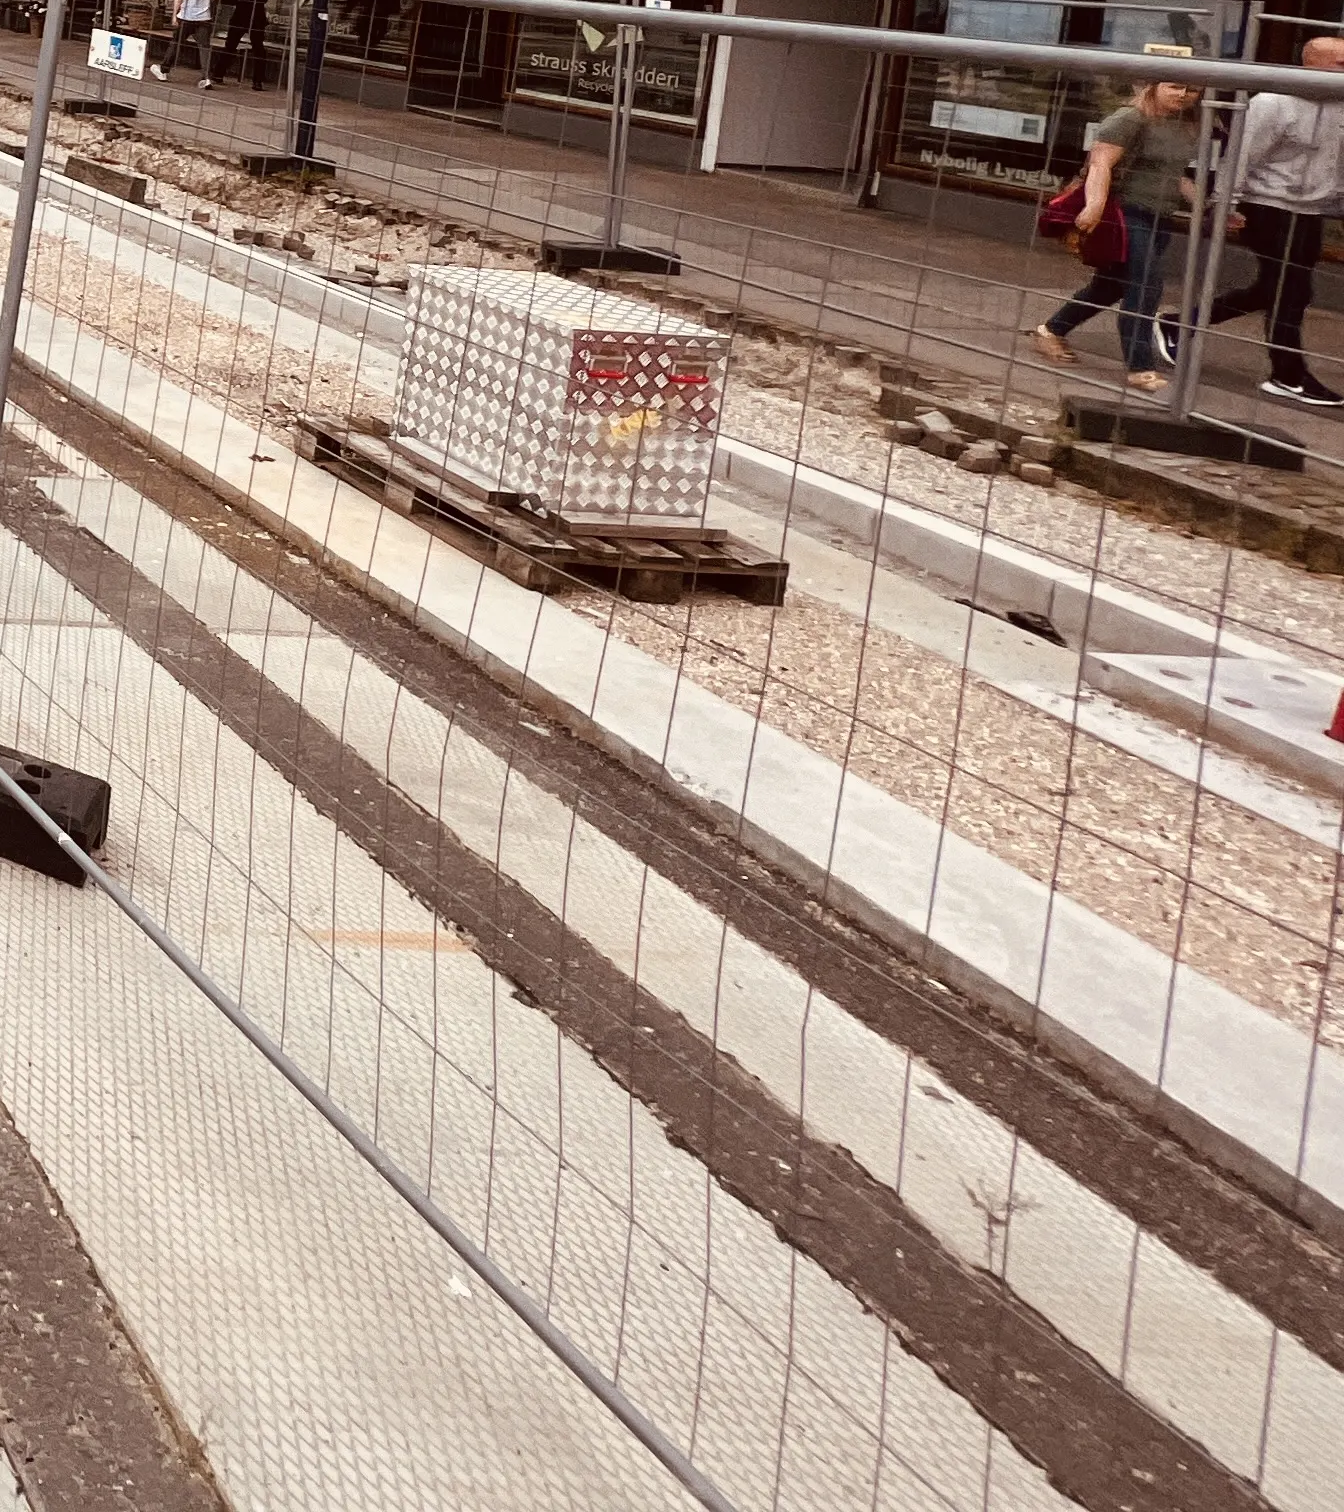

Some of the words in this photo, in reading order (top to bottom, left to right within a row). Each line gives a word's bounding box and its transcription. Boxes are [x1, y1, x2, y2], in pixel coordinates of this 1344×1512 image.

[530, 52, 587, 74] strauss
[919, 148, 989, 178] Nybolig
[994, 161, 1064, 192] Lyngby
